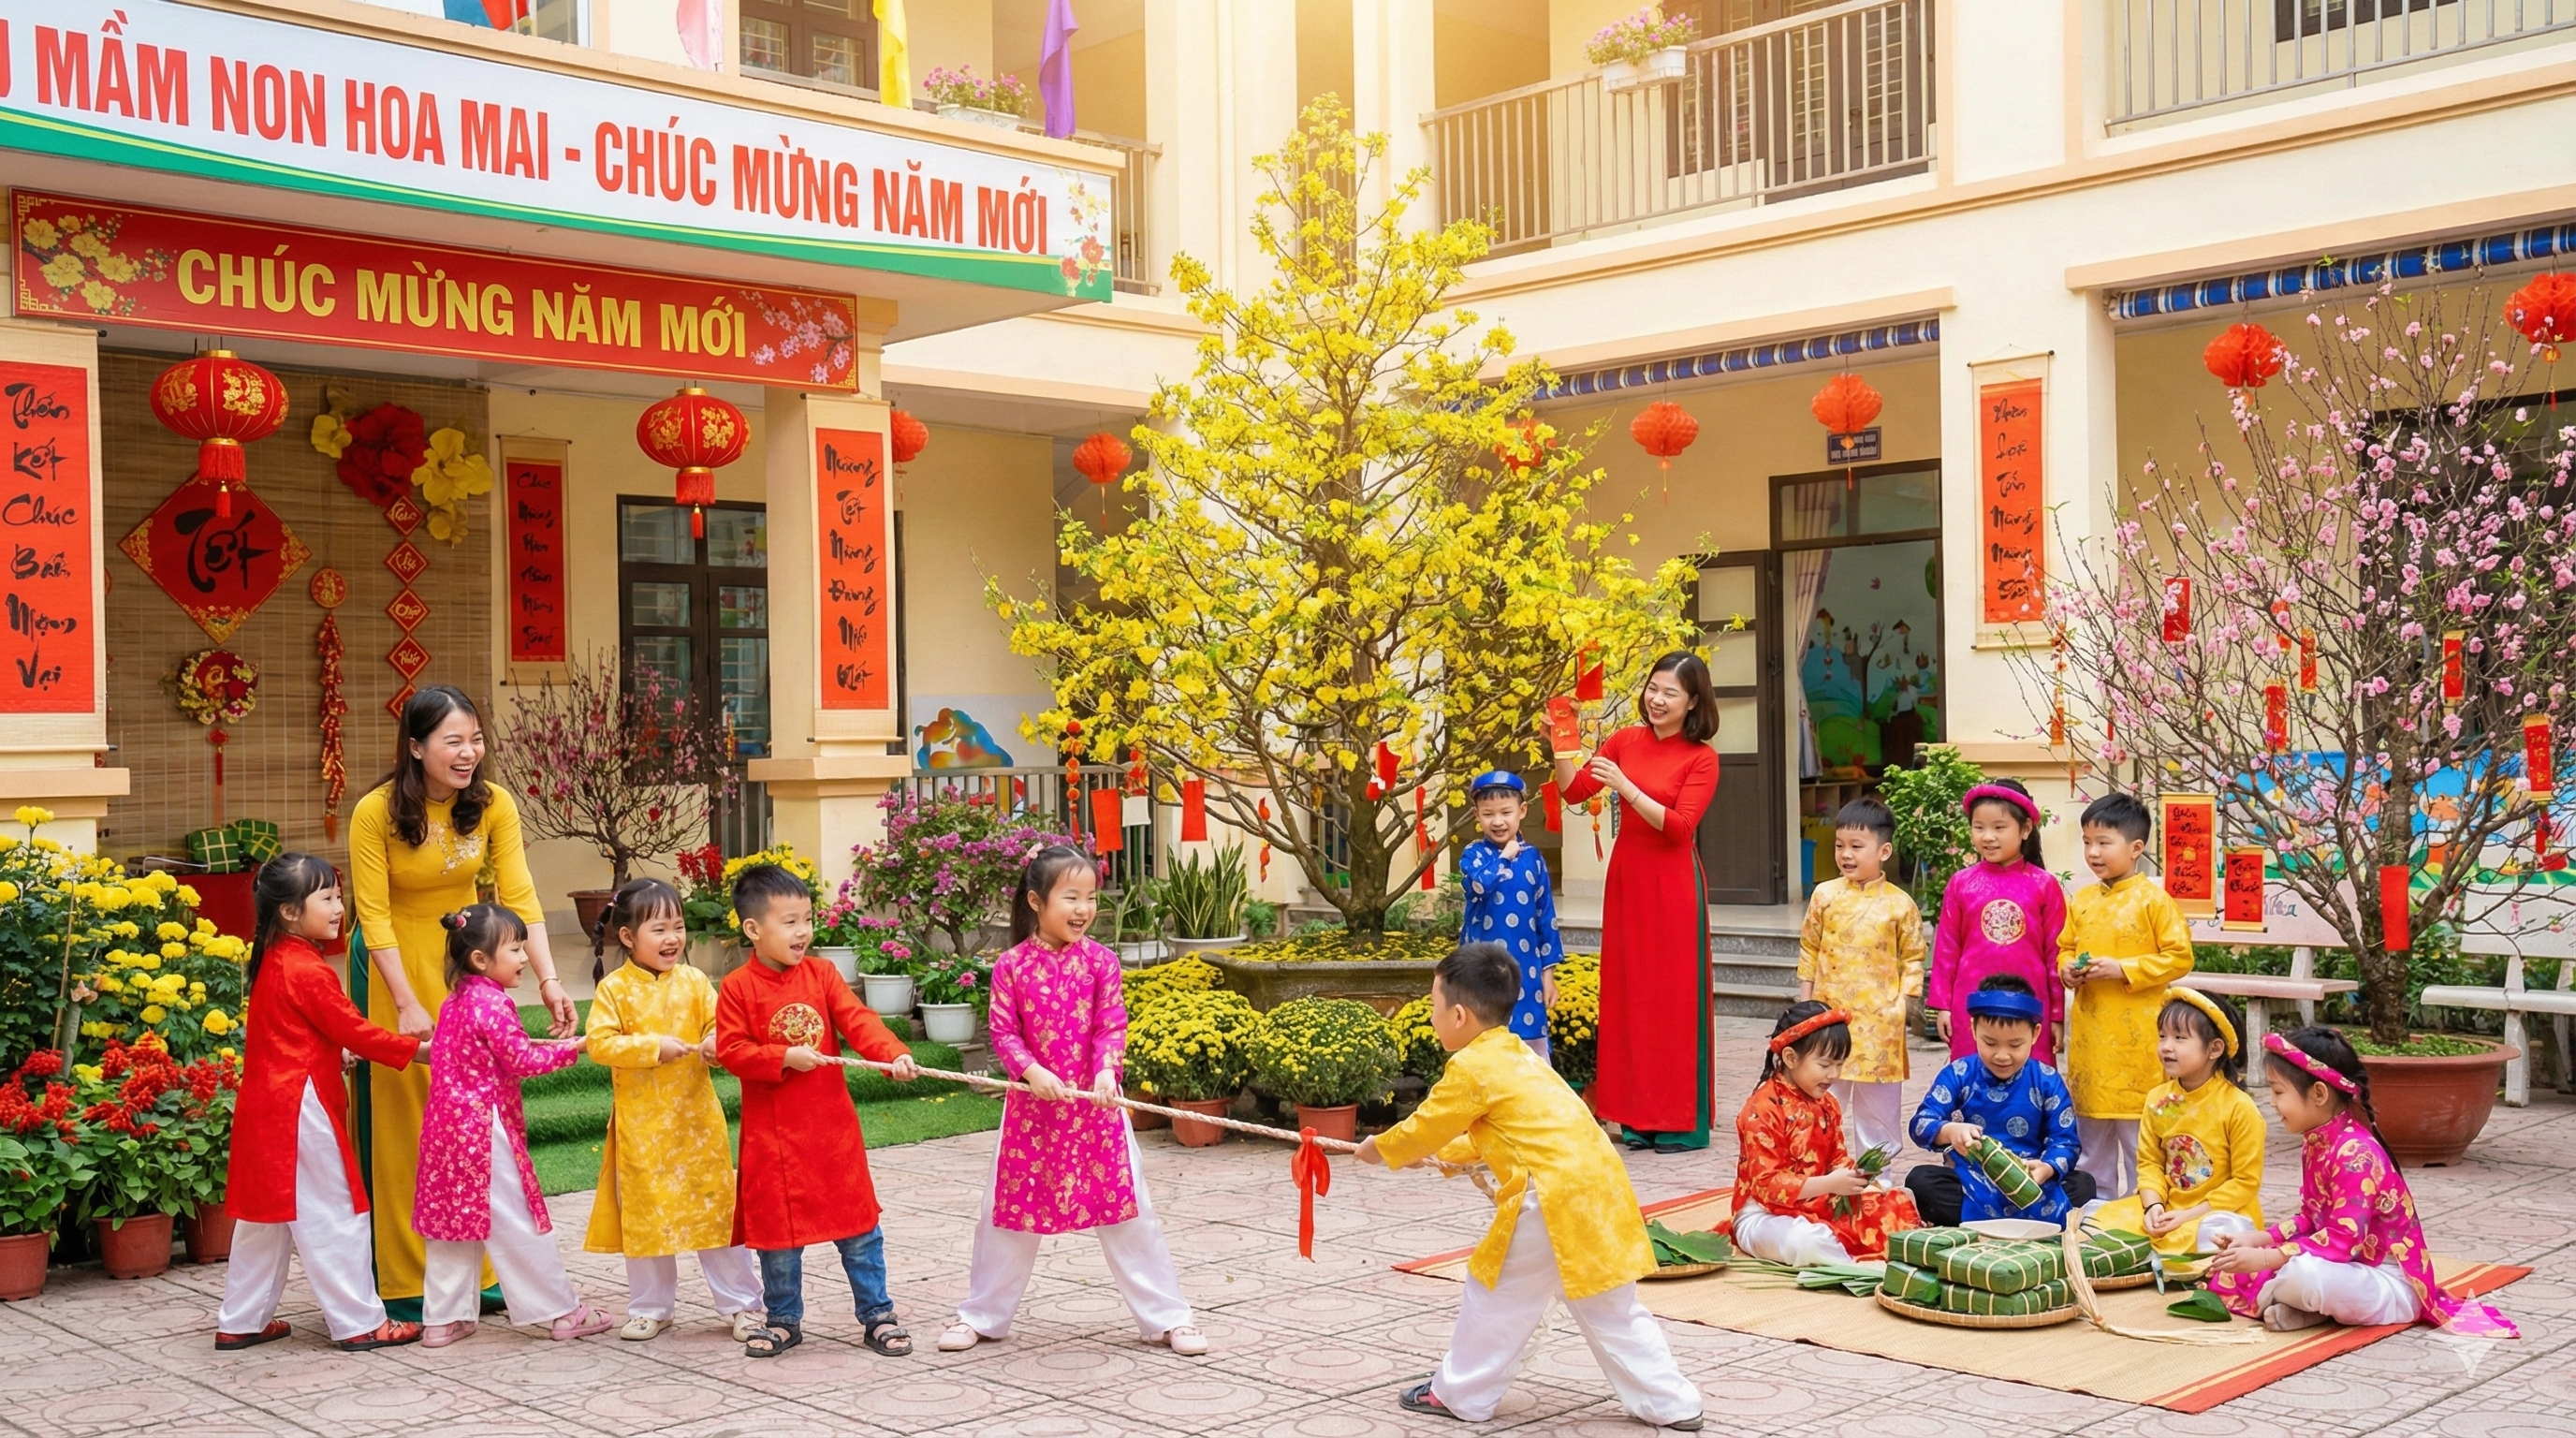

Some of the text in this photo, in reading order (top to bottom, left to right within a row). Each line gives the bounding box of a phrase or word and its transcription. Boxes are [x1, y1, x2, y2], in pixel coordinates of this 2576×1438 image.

[36, 10, 189, 126] MẦM
[210, 56, 327, 147] NON
[345, 79, 445, 165] HOA
[461, 99, 549, 181] MAI
[564, 147, 581, 162] -
[595, 116, 716, 206] CHÚC
[733, 134, 858, 227] MỪNG
[873, 159, 963, 243] NĂM
[977, 175, 1046, 255] MỚI
[177, 244, 746, 359] CHÚC MỪNG NĂM MỚI
[174, 507, 273, 594] Tết
